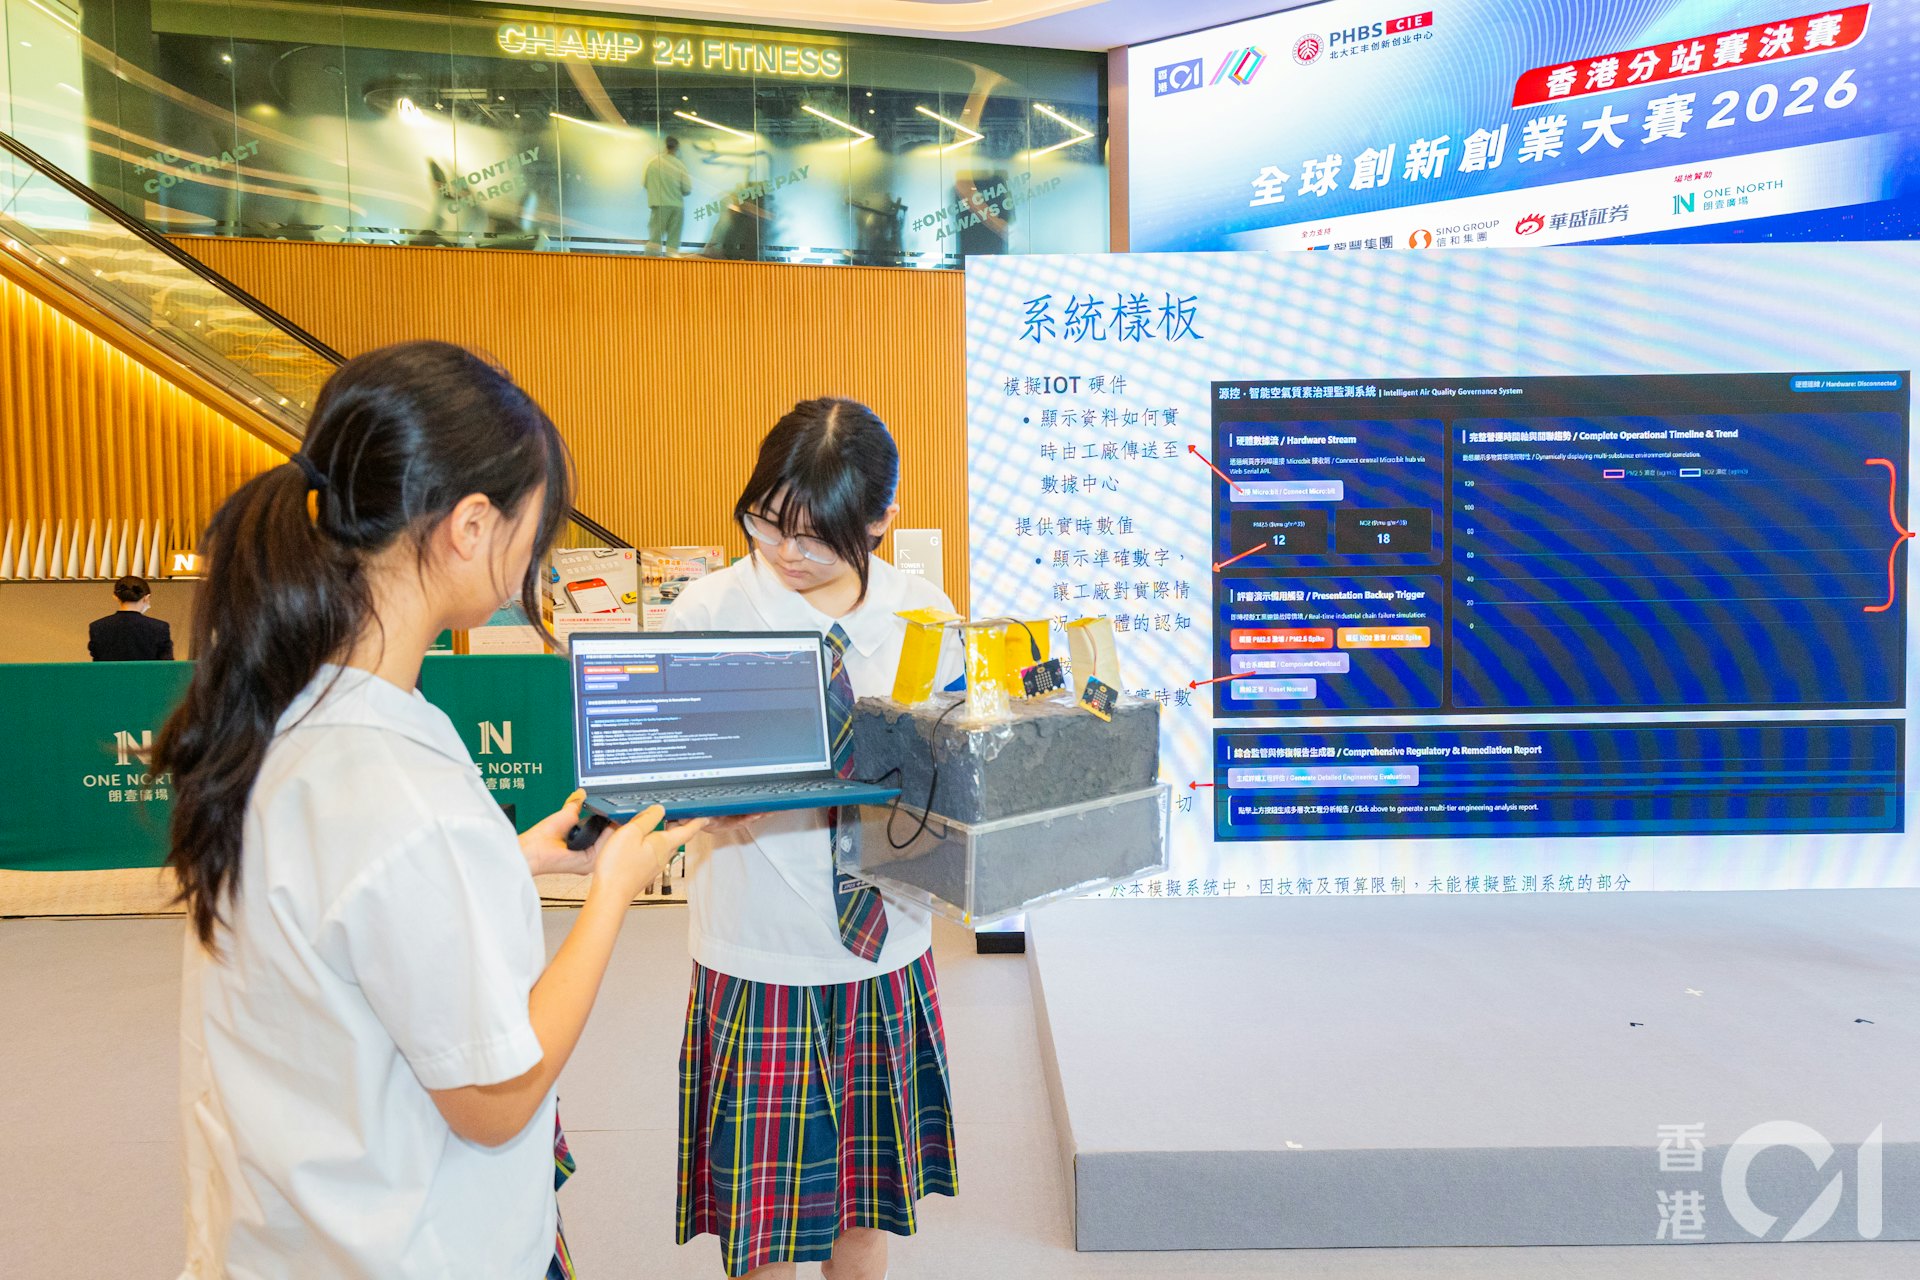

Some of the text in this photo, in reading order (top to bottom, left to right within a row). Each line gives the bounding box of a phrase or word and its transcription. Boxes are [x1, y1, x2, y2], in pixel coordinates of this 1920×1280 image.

[1329, 15, 1423, 46] PHBS CIE
[498, 23, 842, 78] CHAMP 24 FITNESS
[1329, 31, 1433, 60] 北大汇丰创新创业中心
[1546, 14, 1843, 98] 香港分站賽決賽
[143, 140, 259, 194] CONTRACT
[737, 165, 809, 205] PREPAY
[1703, 179, 1783, 199] ONE NORTH
[913, 172, 1031, 232] #ONCE CHAMP
[1703, 196, 1749, 211] 朗壹廣場
[936, 203, 1000, 241] ALWAYS
[1549, 204, 1629, 230] 華盛証券
[1436, 220, 1499, 236] SINO GROUP
[1436, 231, 1487, 247] 信和集團
[1019, 292, 1204, 343] 系統樣板
[1004, 375, 1127, 396] 模擬IOT 硬件
[1383, 388, 1418, 397] Intelligent
[1432, 388, 1456, 397] Quality
[1458, 387, 1497, 395] Governance
[1499, 387, 1523, 397] System
[1040, 408, 1179, 427] 顯示資料如何實
[1287, 436, 1326, 445] Hardware
[1328, 436, 1356, 445] Stream
[1579, 431, 1618, 442] Complete
[1620, 431, 1667, 441] Operational
[1669, 430, 1704, 439] Timeline
[1705, 430, 1713, 438] &
[1715, 429, 1738, 438] Trend
[1040, 441, 1180, 460] 時由工廠傳送至
[1041, 475, 1120, 494] 數據中心
[1015, 517, 1134, 536] 提供實時數值
[929, 536, 939, 546] G
[1273, 534, 1286, 545] 12
[1377, 533, 1390, 544] 18
[1053, 582, 1190, 600] 讓工廠對實際情
[1312, 592, 1363, 601] Presentation
[1365, 591, 1394, 601] Backup
[1395, 590, 1425, 601] Trigger
[1281, 661, 1313, 669] Compound
[1343, 746, 1404, 757] Comprehensive
[1406, 746, 1450, 757] Regulatory
[1452, 746, 1460, 755] &
[1461, 745, 1512, 754] Remediation
[1514, 745, 1542, 756] Report
[488, 762, 543, 774] NORTH
[83, 774, 121, 787] ONE
[486, 778, 525, 790] 壹廣場
[1342, 773, 1378, 782] Engineering
[1458, 804, 1493, 813] engineering
[1494, 804, 1517, 812] analysis
